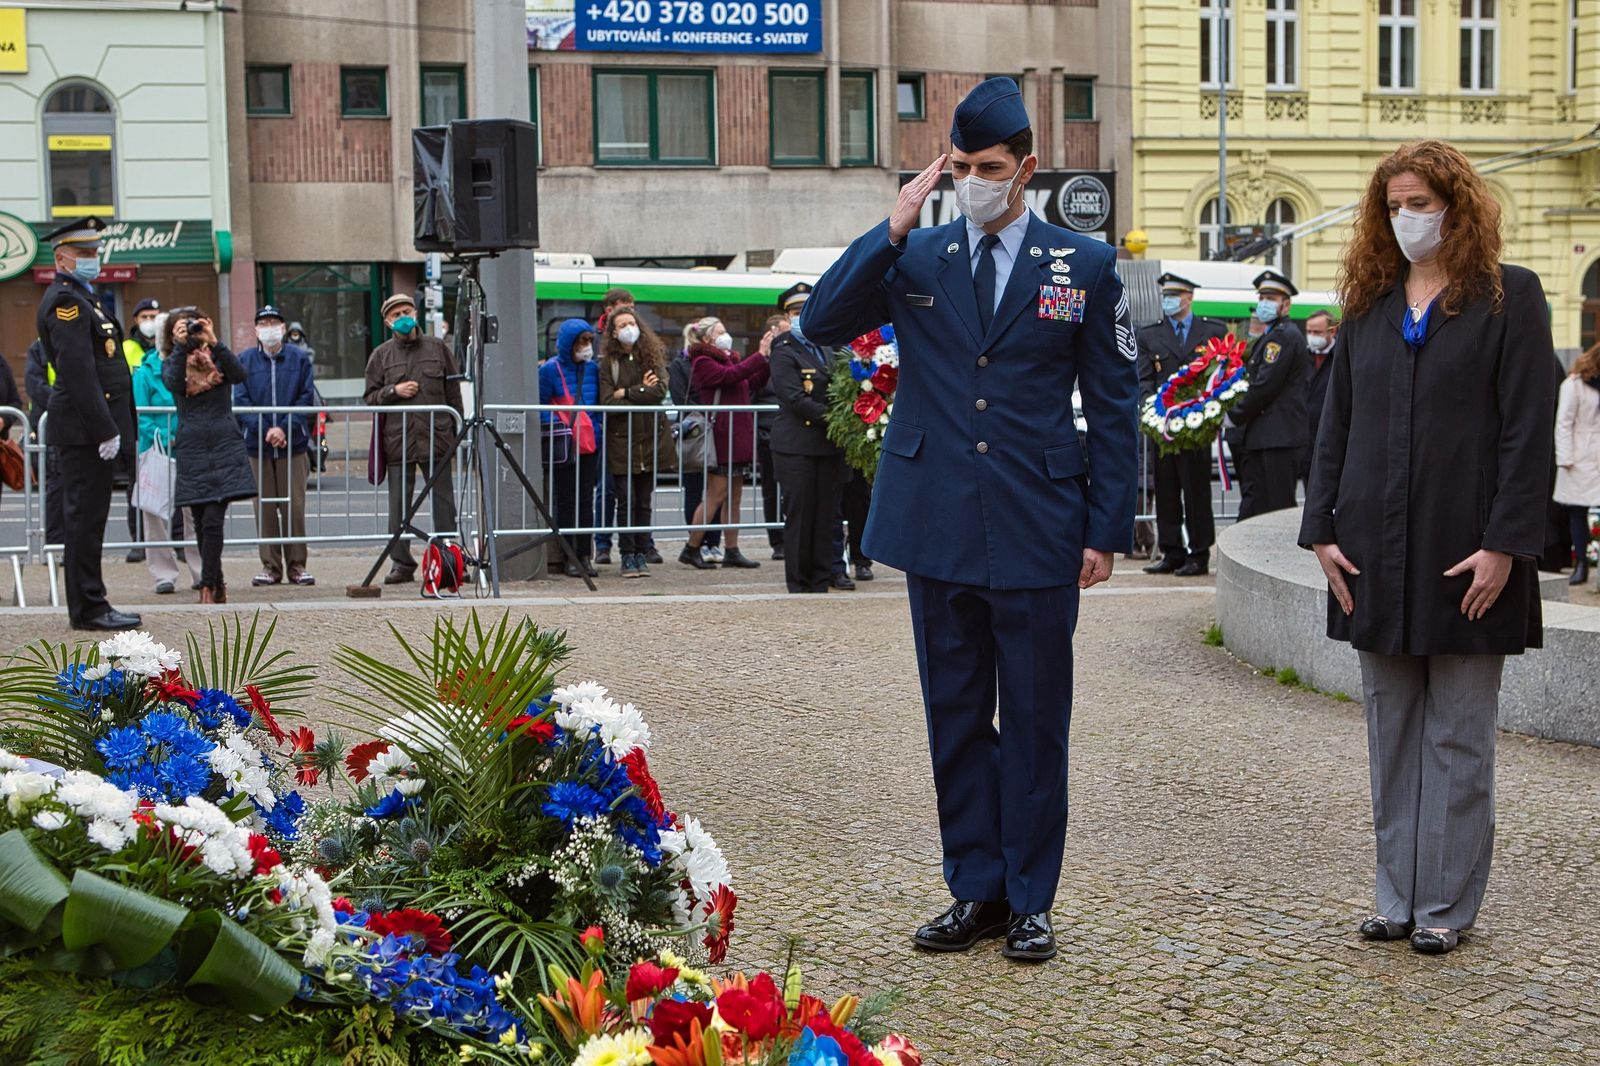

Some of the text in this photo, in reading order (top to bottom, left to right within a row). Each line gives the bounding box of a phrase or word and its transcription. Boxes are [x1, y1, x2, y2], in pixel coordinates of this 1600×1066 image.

[586, 0, 809, 25] +420 378 020 500
[587, 28, 808, 45] UBYTOVÁNÍ KONFERENCE SVATBY
[1071, 192, 1101, 203] LUCKY
[1069, 202, 1102, 214] STRIKE
